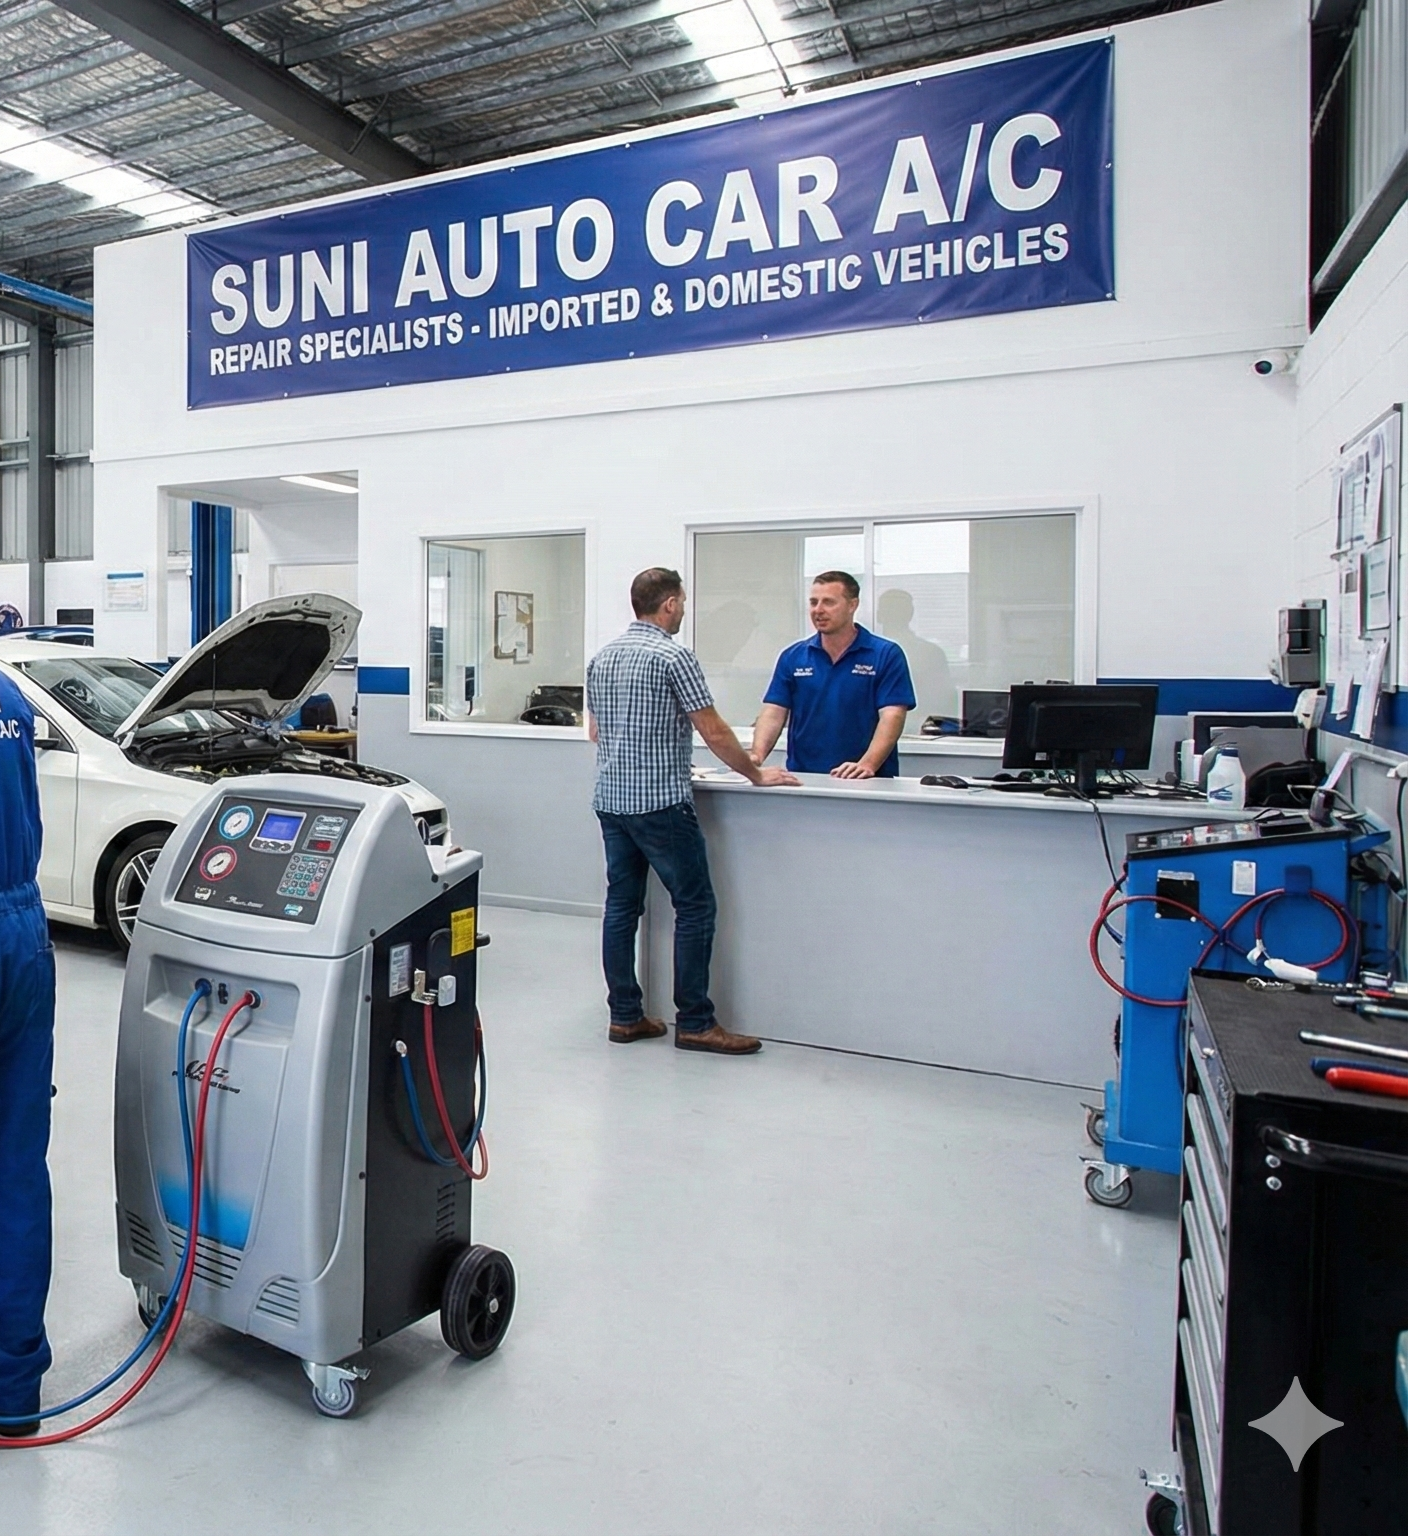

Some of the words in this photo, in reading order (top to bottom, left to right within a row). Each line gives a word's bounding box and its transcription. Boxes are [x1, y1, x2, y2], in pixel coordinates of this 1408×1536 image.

[209, 239, 370, 336] SUNI
[394, 197, 615, 309] AUTO
[644, 154, 845, 268] CAR
[871, 111, 1064, 236] A/C
[209, 337, 294, 377] REPAIR
[298, 312, 465, 365] SPECIALISTS
[488, 287, 642, 340] IMPORTED
[650, 281, 675, 318] &
[684, 253, 863, 313] DOMESTIC
[871, 222, 1070, 286] VEHICLES
